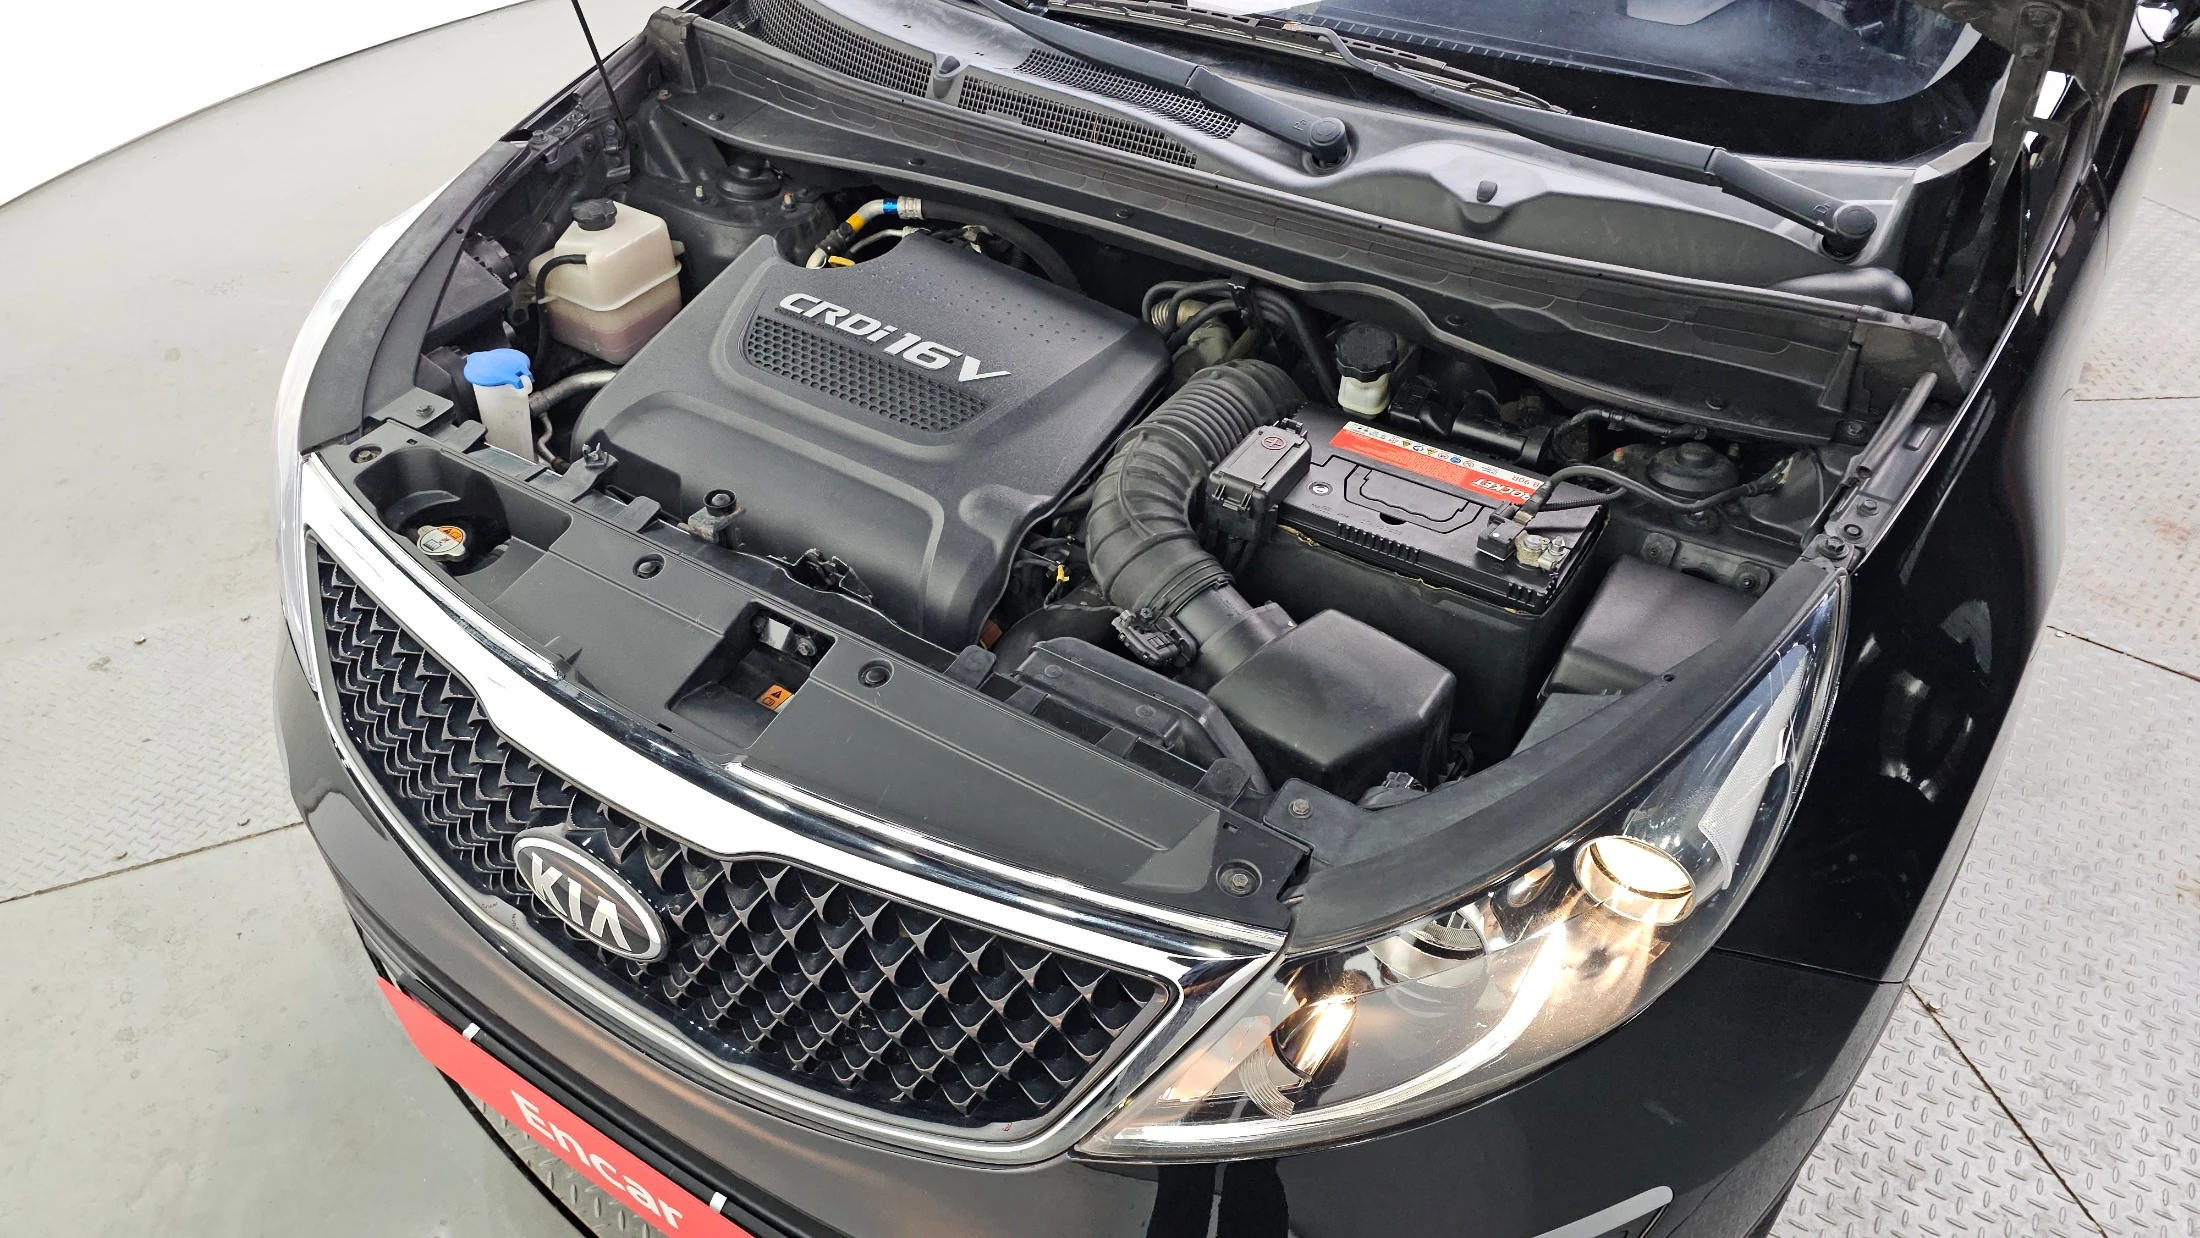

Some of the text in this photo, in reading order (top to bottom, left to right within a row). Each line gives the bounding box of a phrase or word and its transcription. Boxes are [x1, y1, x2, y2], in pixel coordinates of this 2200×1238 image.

[1471, 477, 1531, 501] ROCKET
[531, 851, 633, 952] KIA
[510, 1089, 684, 1230] Encar
